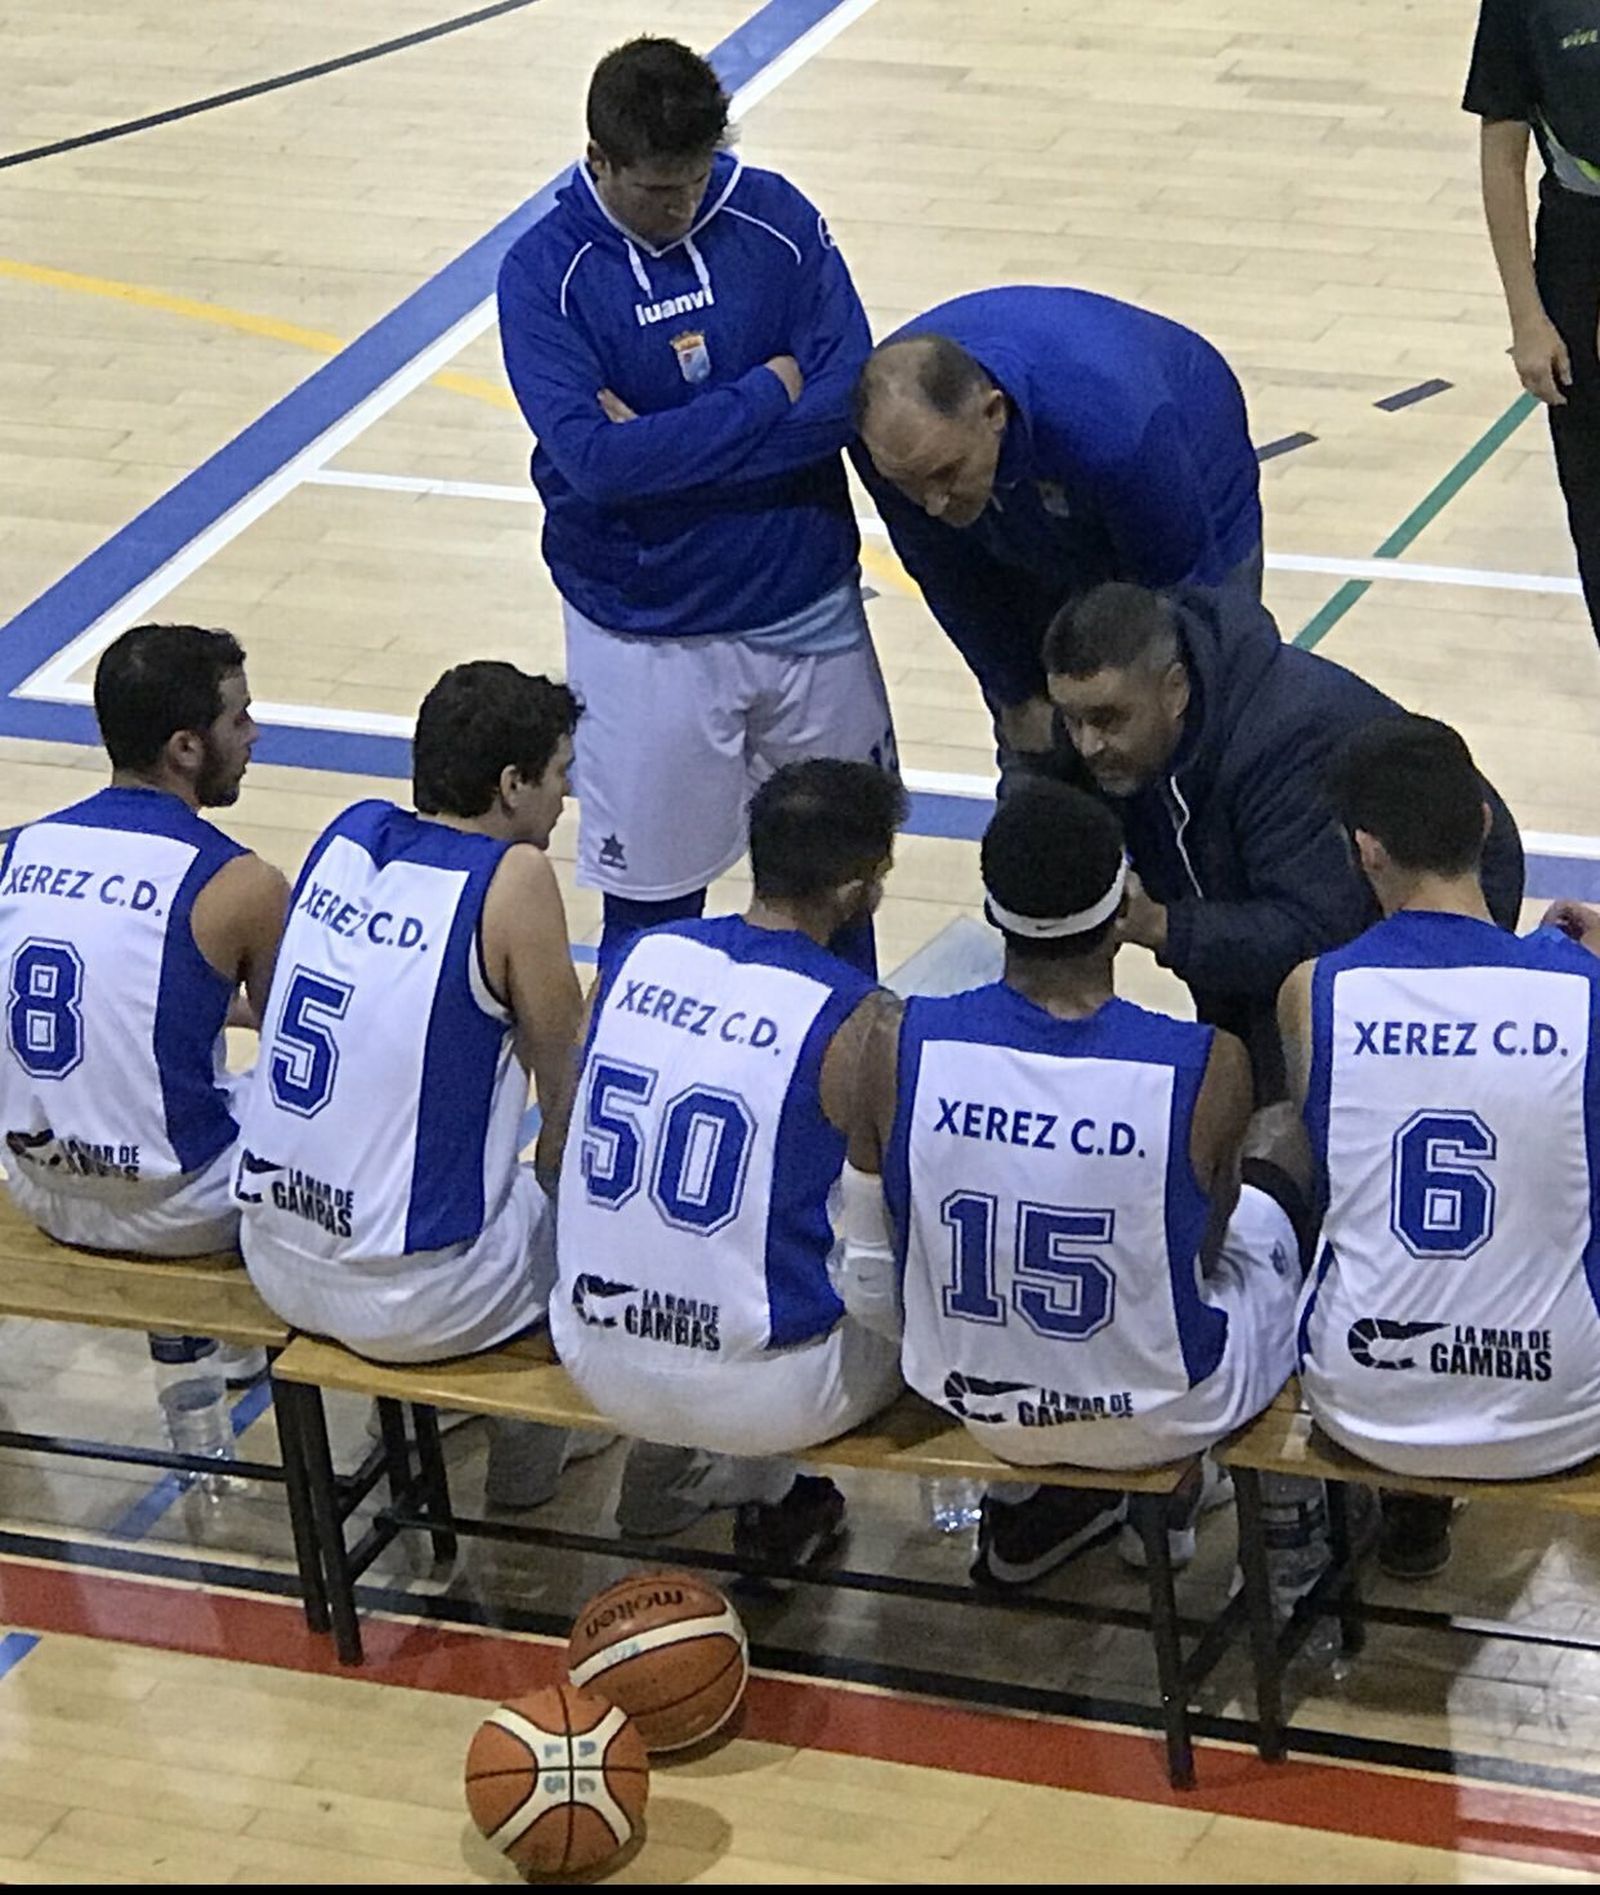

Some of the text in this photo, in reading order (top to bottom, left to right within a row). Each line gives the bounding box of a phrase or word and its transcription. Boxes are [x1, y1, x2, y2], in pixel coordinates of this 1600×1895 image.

[2, 865, 163, 917] XEREZ C.D.
[367, 911, 428, 952] C.D.
[7, 936, 85, 1081] 8
[616, 979, 782, 1056] XEREZ C.D.
[268, 963, 355, 1119] 5
[1352, 1020, 1568, 1057] XEREZ C.D.
[581, 1053, 758, 1237] 50
[934, 1097, 1146, 1158] XEREZ C.D.
[119, 1145, 140, 1165] DE
[335, 1188, 355, 1210] DE
[1390, 1108, 1497, 1260] 6
[941, 1189, 1116, 1342] 15
[625, 1304, 721, 1351] GAMBAS
[700, 1303, 720, 1324] DE
[1455, 1325, 1551, 1350] LA MAR DE
[1430, 1342, 1552, 1381] GAMBAS
[1064, 1393, 1105, 1413] MAR
[1110, 1391, 1134, 1413] DE
[586, 1589, 684, 1638] molten
